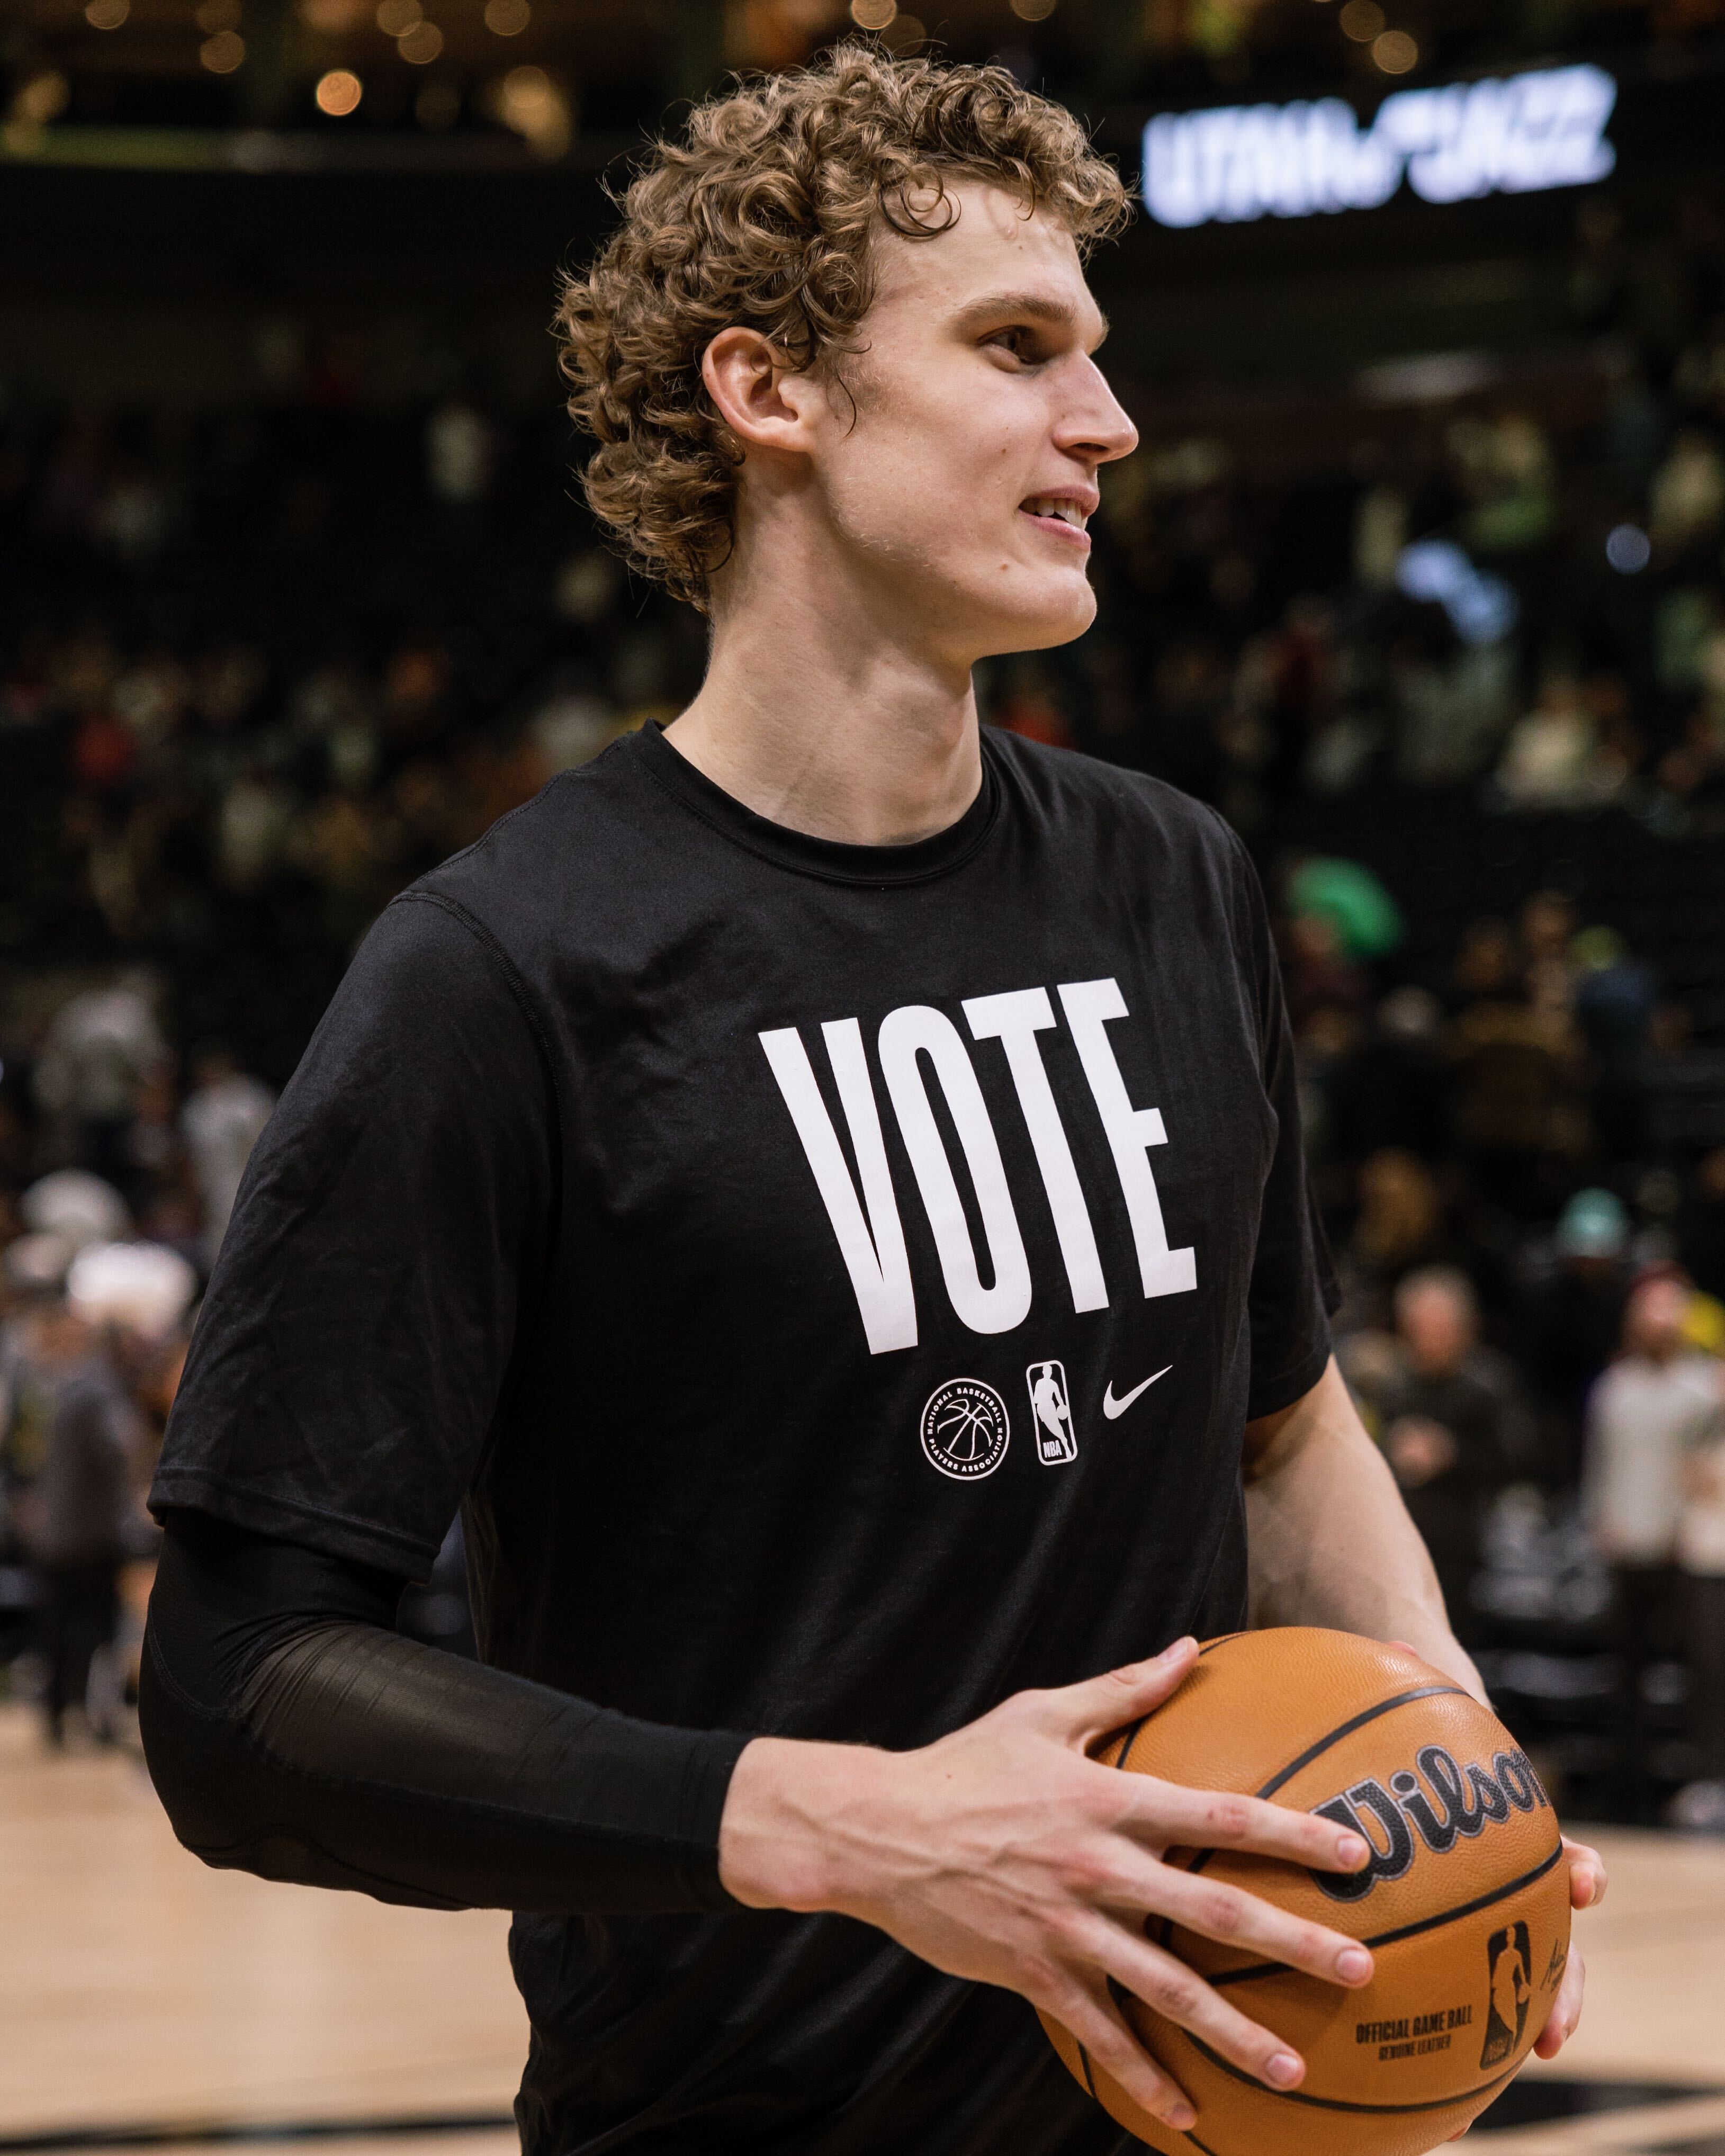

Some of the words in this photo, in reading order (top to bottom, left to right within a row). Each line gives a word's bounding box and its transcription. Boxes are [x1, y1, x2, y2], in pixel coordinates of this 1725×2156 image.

[758, 977, 1197, 1354] VOTE
[927, 1391, 953, 1434] NATIONAL
[957, 1387, 1002, 1423] BASKETBALL
[929, 1439, 958, 1470] PLAYERS
[962, 1427, 1003, 1472] ASSOCIATION
[1043, 1440, 1062, 1458] NBA
[1356, 2018, 1409, 2044] OFFICIAL
[1413, 2010, 1445, 2036] GAME
[1447, 2004, 1472, 2029] BALL
[1379, 2041, 1415, 2061] GENUINE
[1417, 2034, 1451, 2055] LEATHER
